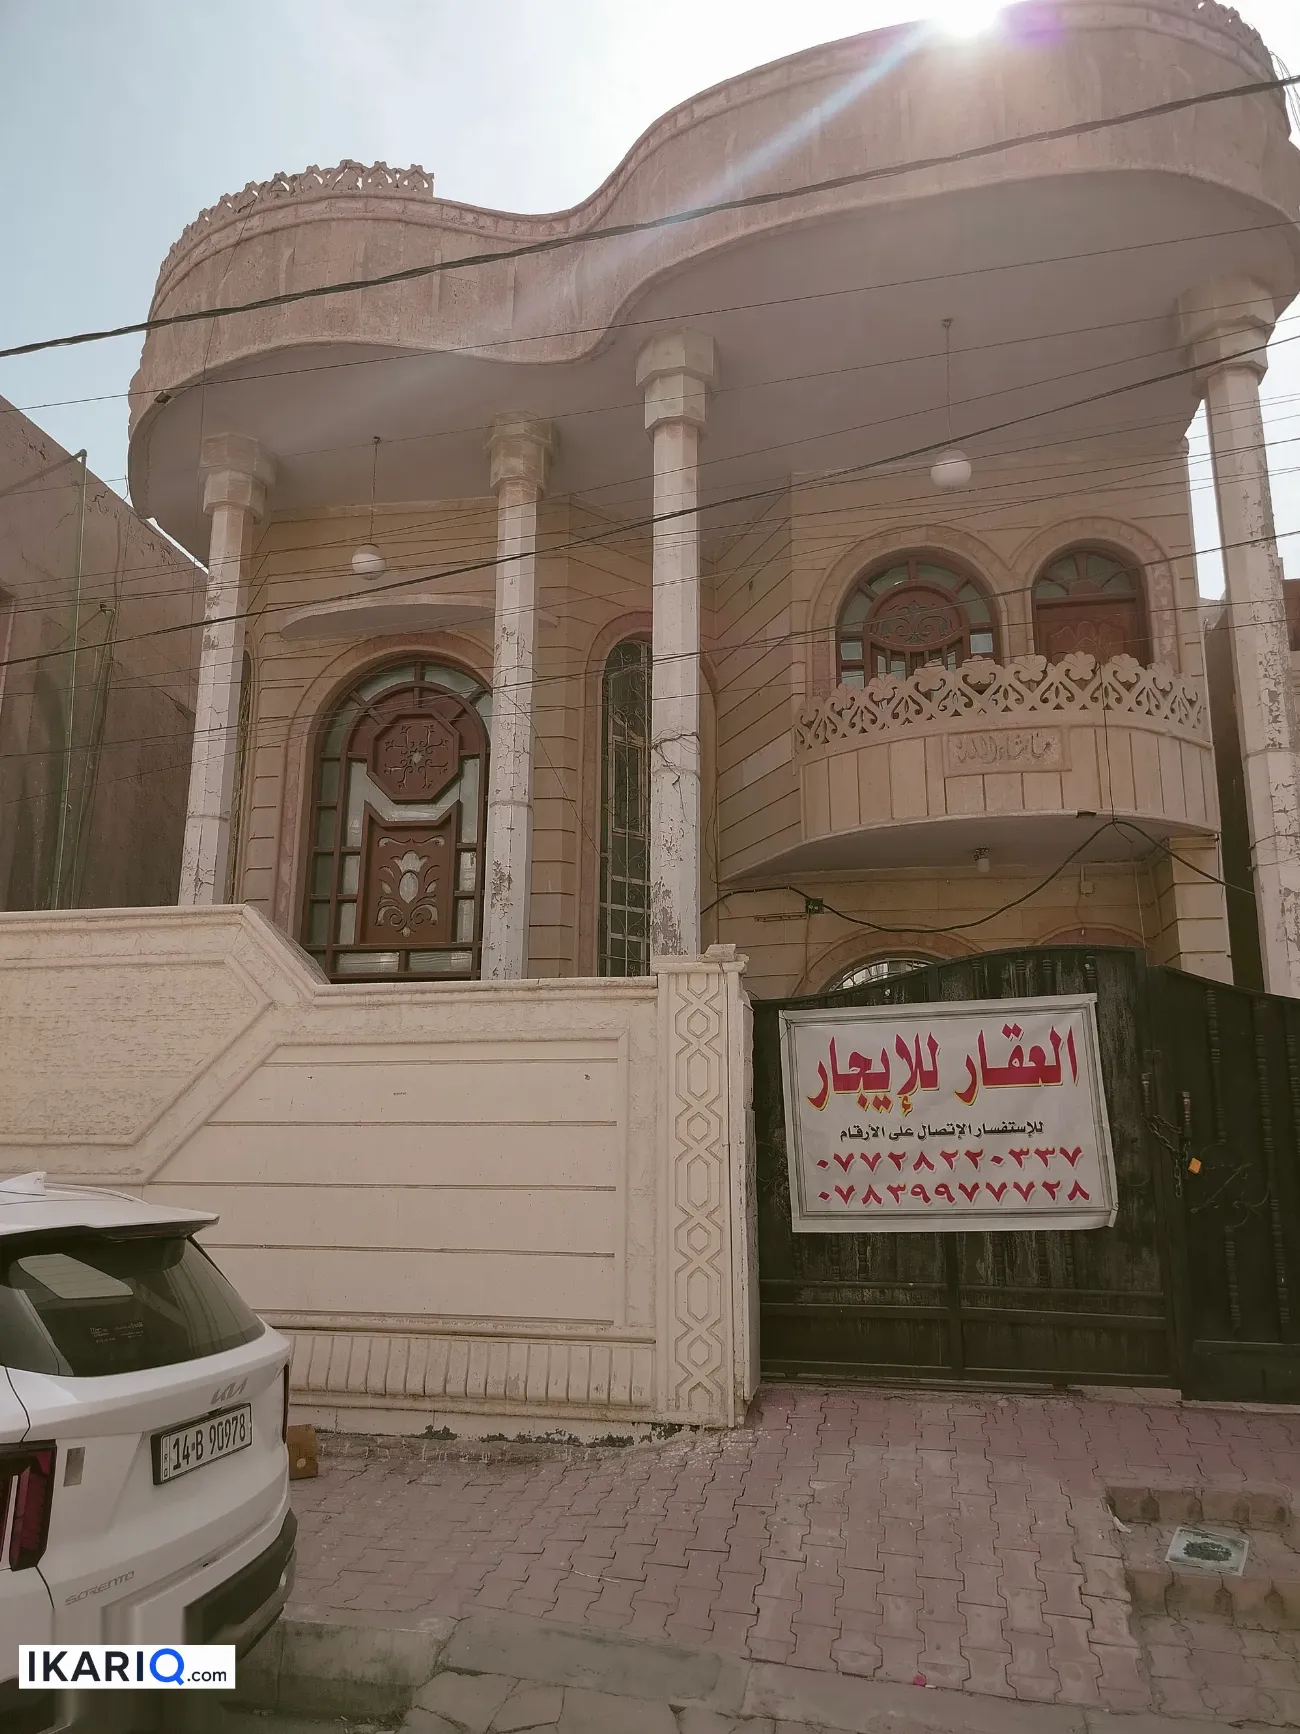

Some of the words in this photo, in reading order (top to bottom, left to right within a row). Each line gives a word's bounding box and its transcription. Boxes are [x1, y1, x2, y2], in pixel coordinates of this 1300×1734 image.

[806, 1032, 941, 1117] للإيجار
[954, 1022, 1080, 1106] العقار
[840, 1123, 885, 1143] الأرقام
[889, 1125, 914, 1142] على
[974, 1120, 1045, 1139] للإستفسار
[816, 1146, 1083, 1173] ٠٧٧٢٨٢٢٠٣٣٧
[818, 1180, 1091, 1205] ٠٧٨٣٩٩٧٧٧٢٨
[209, 1412, 246, 1455] 90978
[65, 1570, 135, 1606] SORENTO
